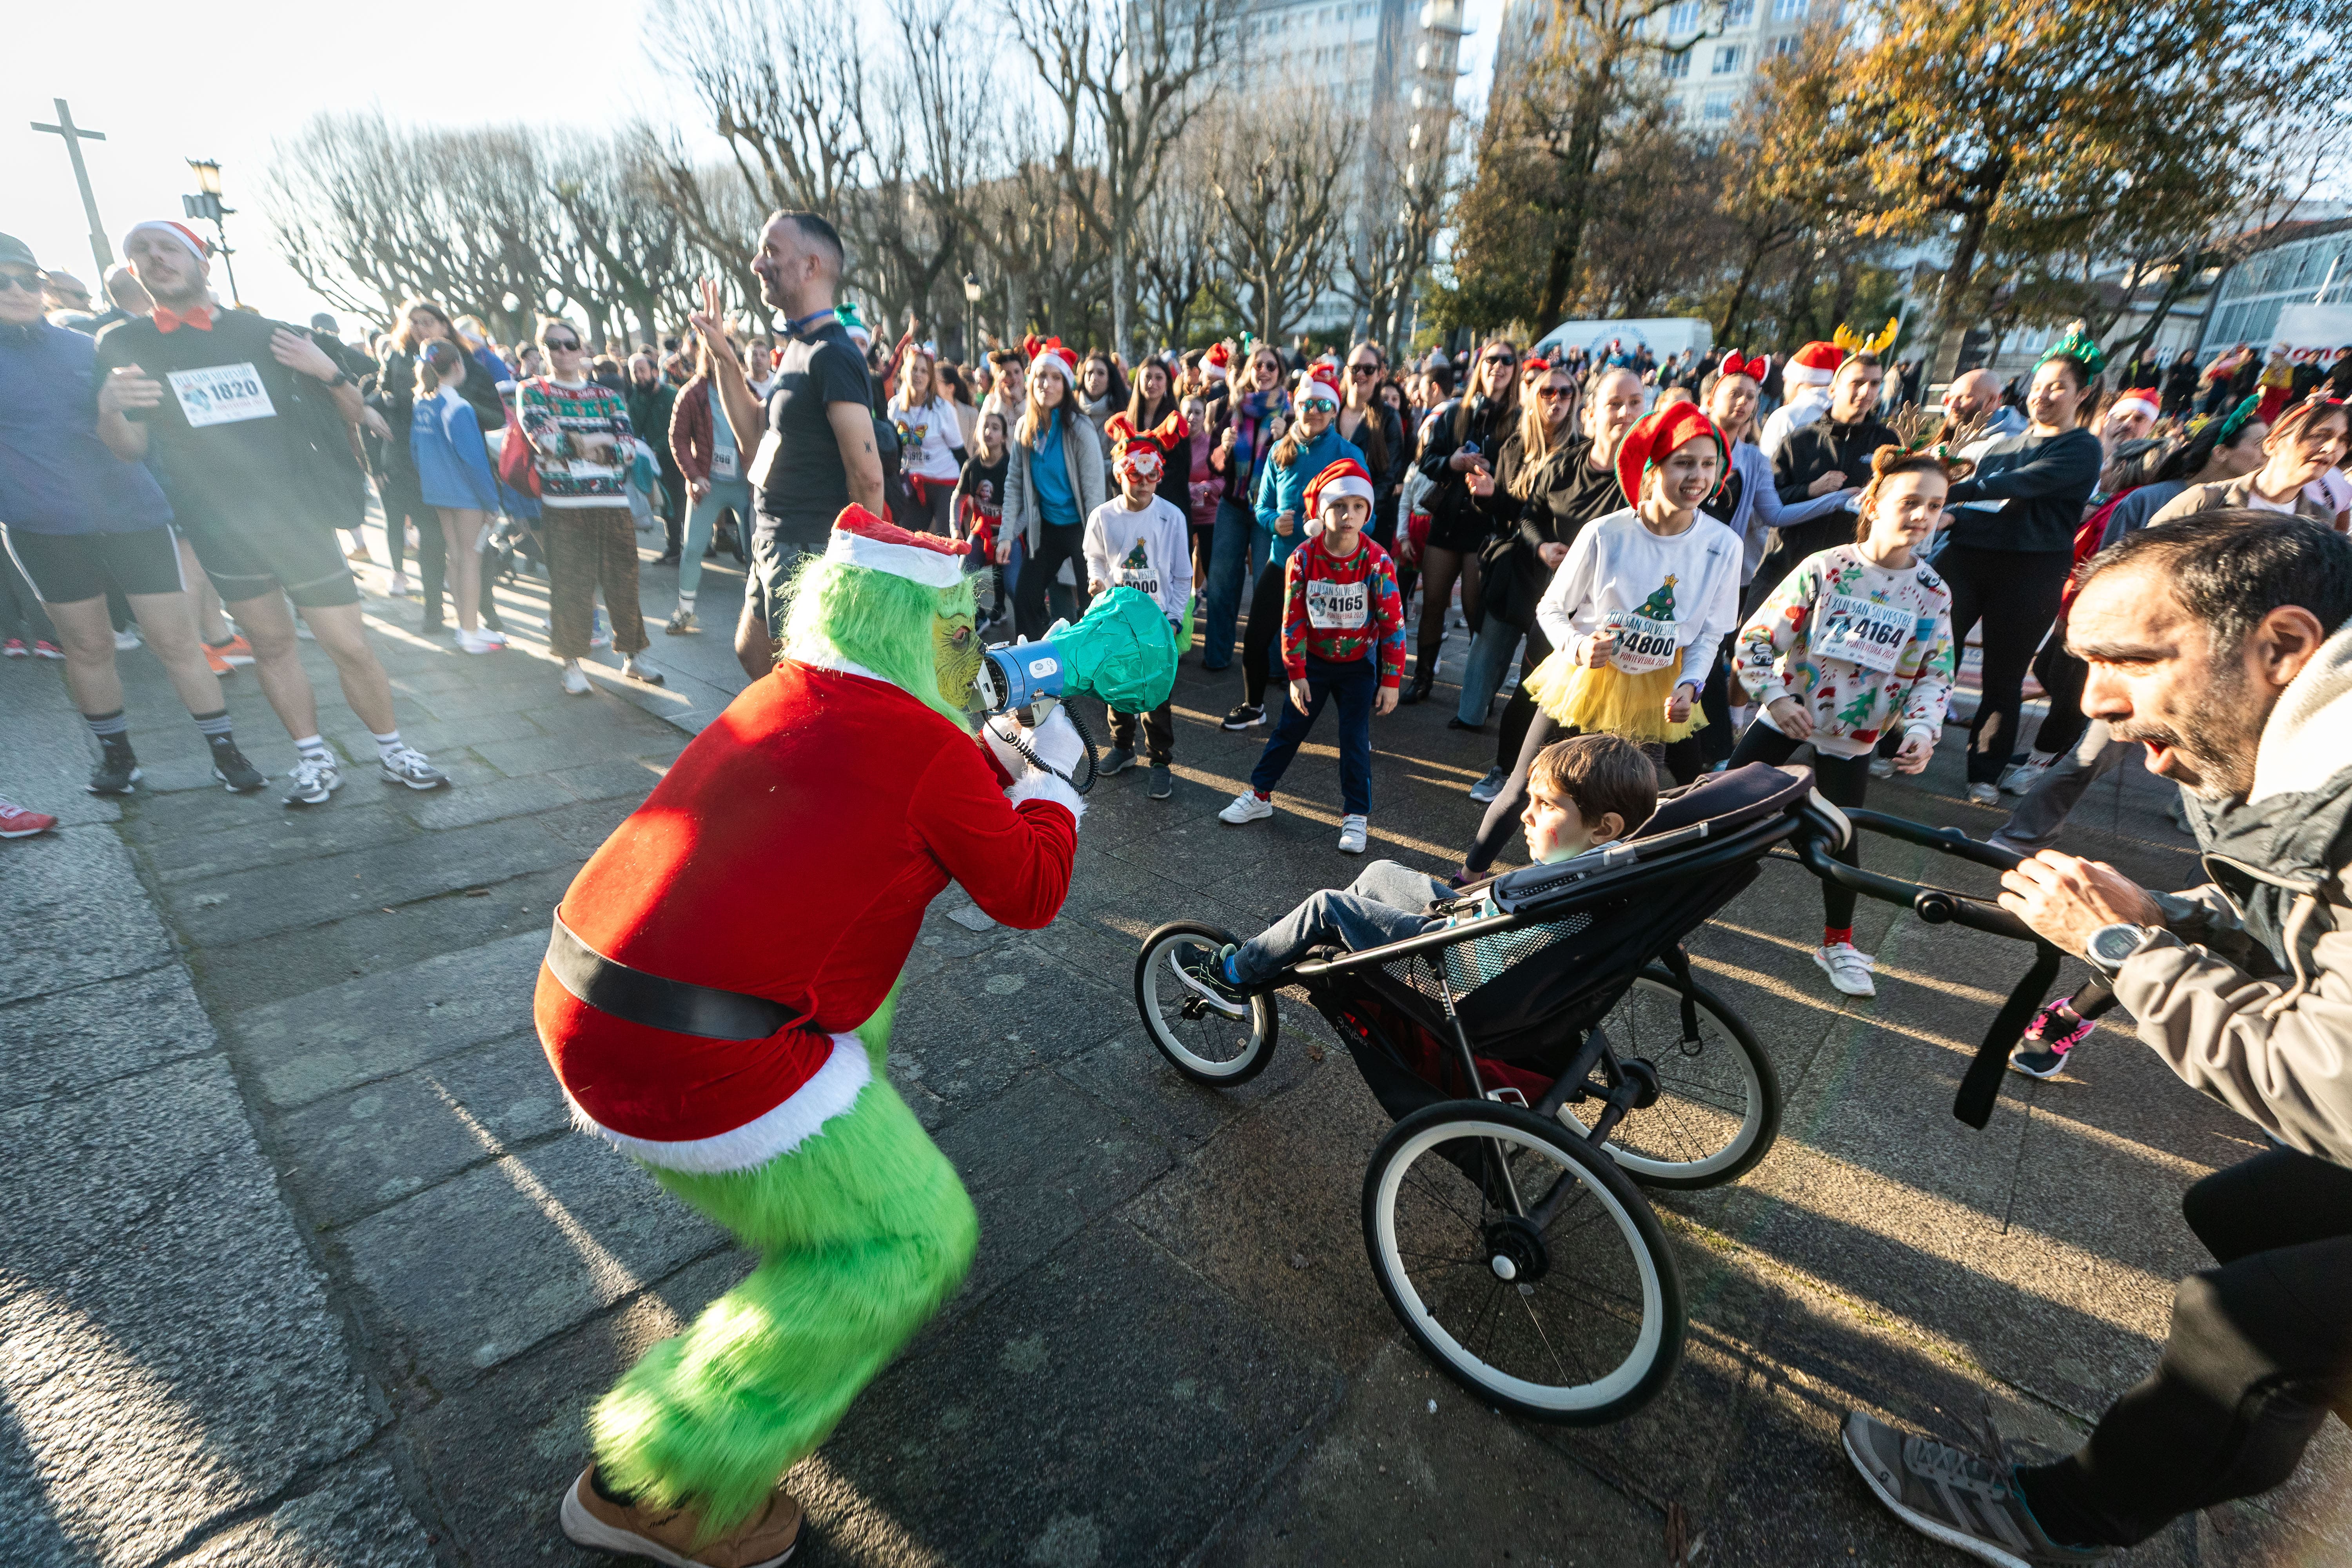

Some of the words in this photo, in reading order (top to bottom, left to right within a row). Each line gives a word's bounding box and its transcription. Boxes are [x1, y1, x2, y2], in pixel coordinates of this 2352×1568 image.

[208, 379, 260, 401] 1820
[1131, 570, 1156, 580] SILVESTRE
[1310, 583, 1322, 593] XLII
[1321, 585, 1333, 595] SAN
[1335, 584, 1364, 596] SILVESTRE
[1328, 594, 1363, 612] 4165
[1831, 597, 1850, 610] XLII
[1850, 601, 1871, 616] SAN
[1869, 606, 1914, 627] SILVESTRE
[1608, 611, 1624, 625] XLII
[1624, 615, 1643, 631] SAN
[1643, 621, 1678, 635] SILVESTRE
[1853, 617, 1906, 648] 4164
[1624, 632, 1675, 657] 4800
[1846, 639, 1883, 655] PONTEVEDRA
[1882, 648, 1898, 659] 2025
[1620, 652, 1656, 666] PONTEVEDRA
[1345, 1025, 1368, 1048] cybex
